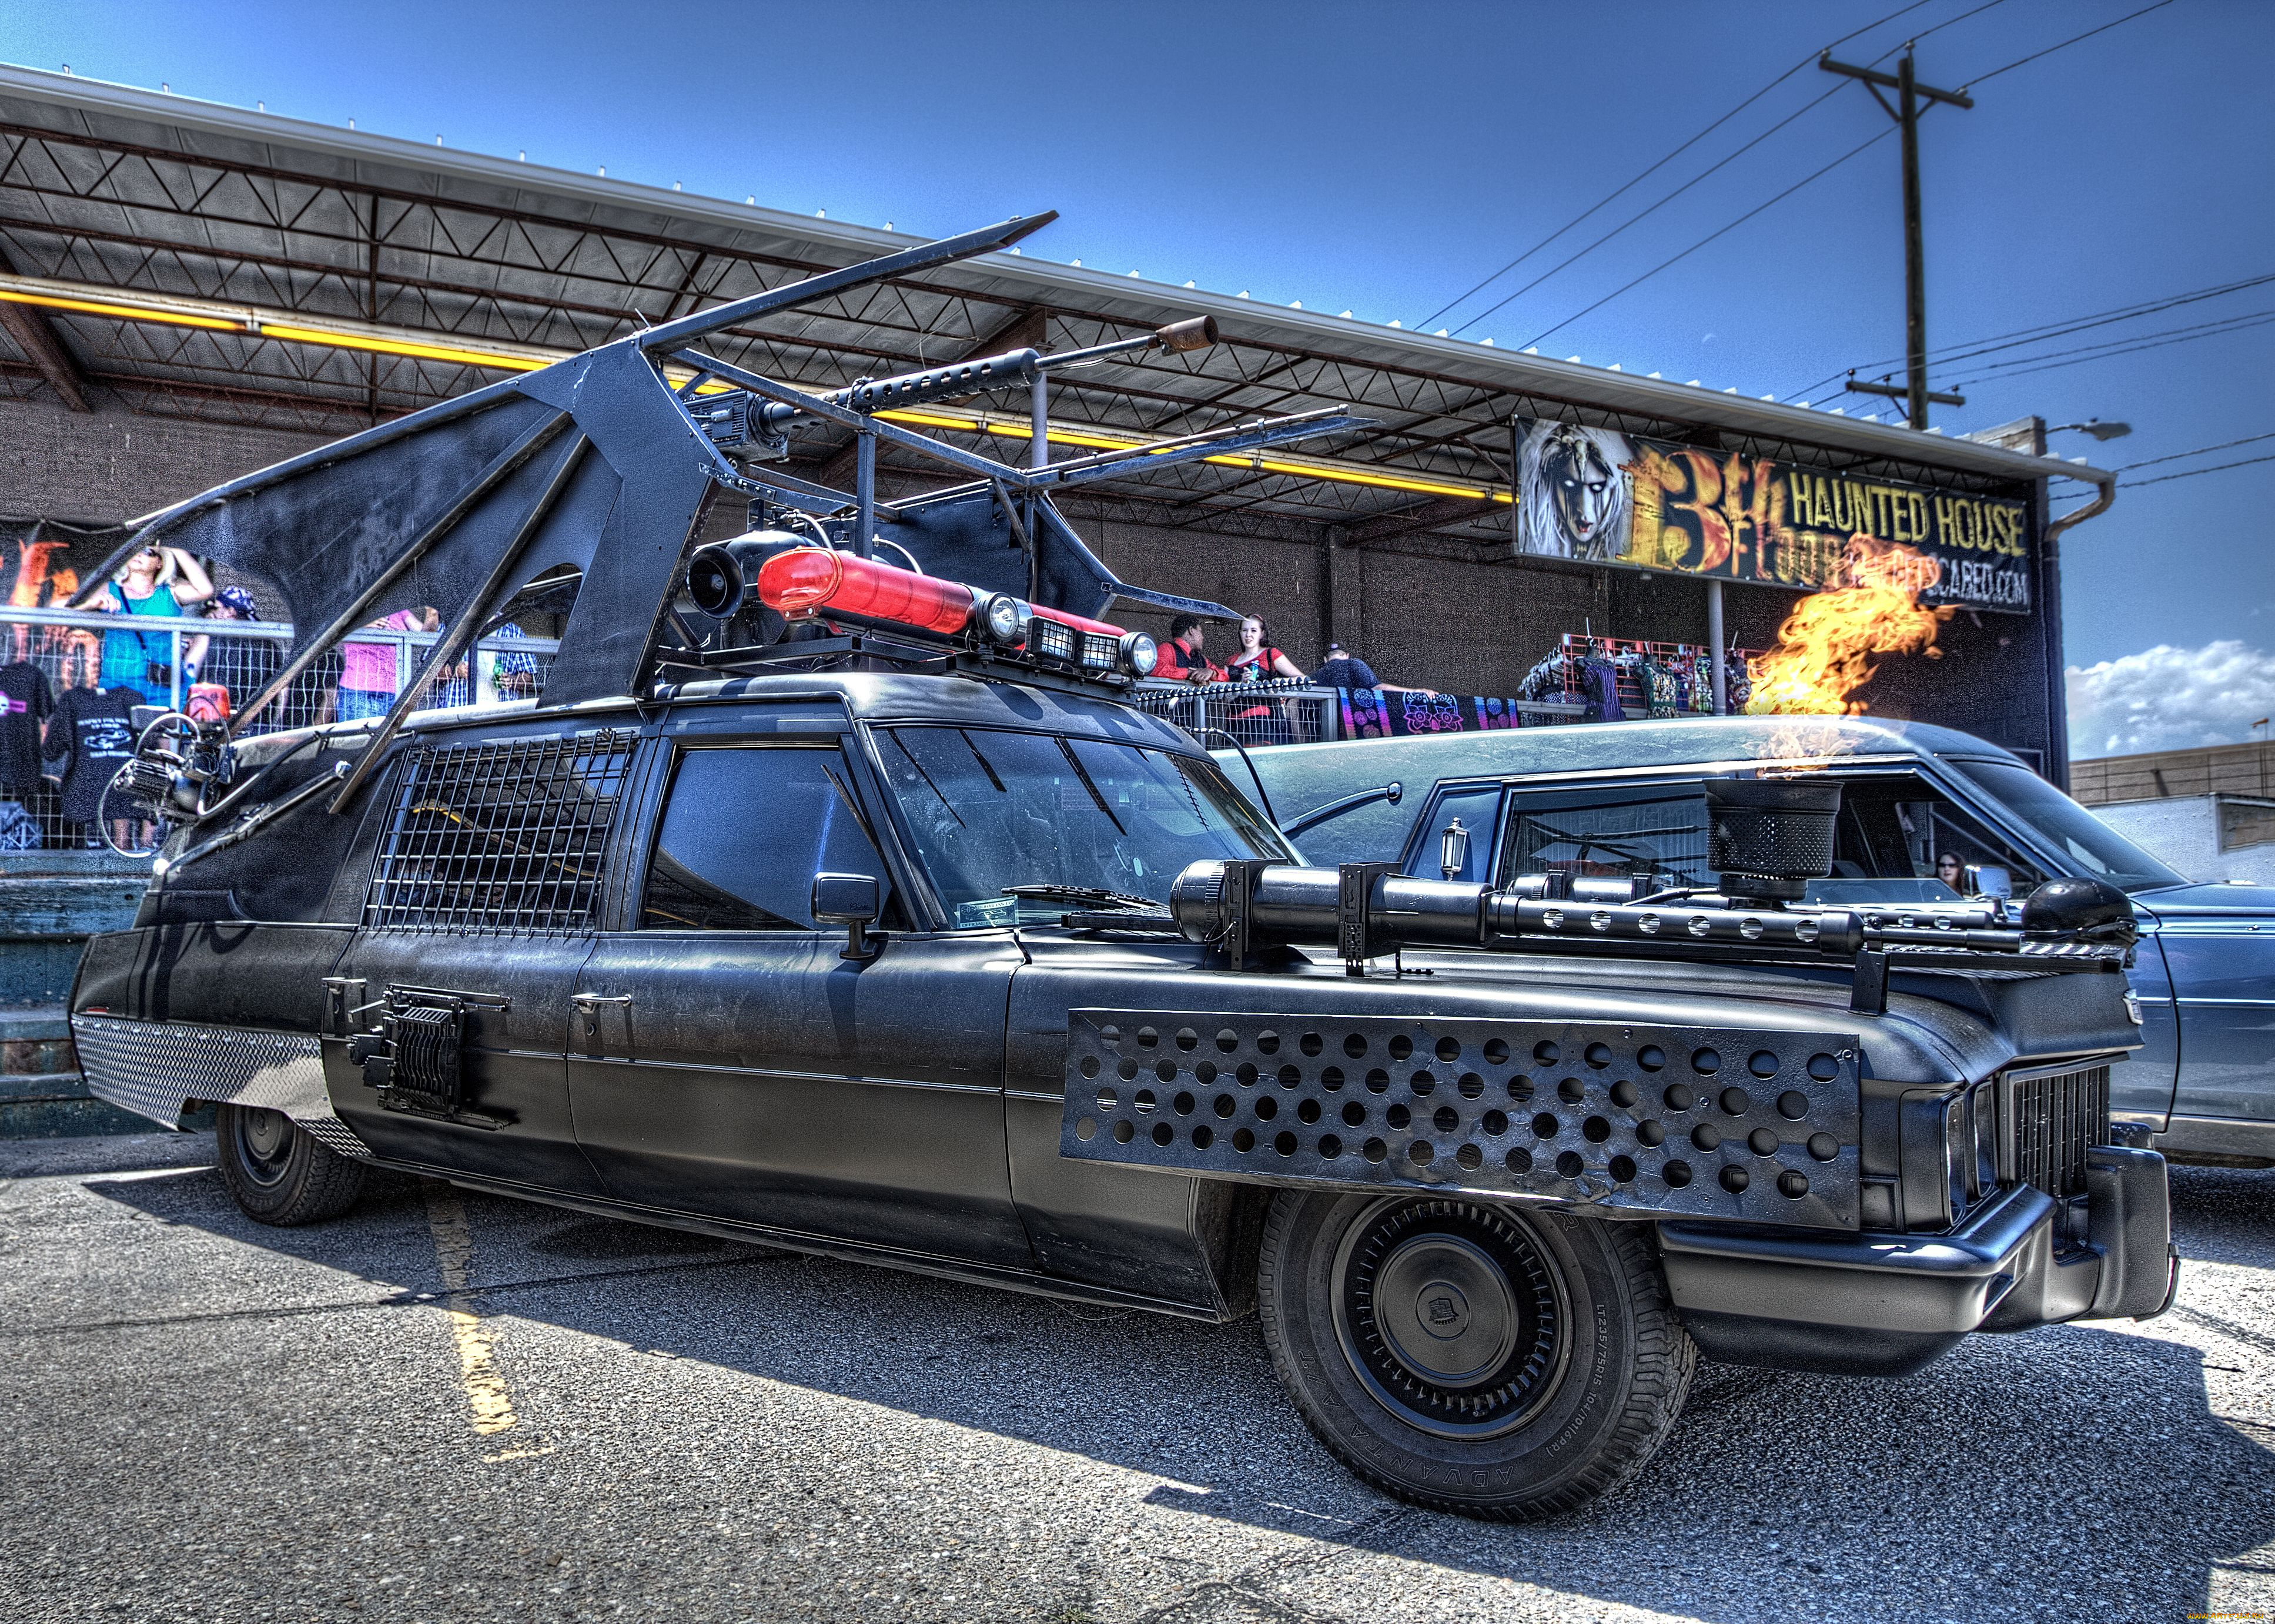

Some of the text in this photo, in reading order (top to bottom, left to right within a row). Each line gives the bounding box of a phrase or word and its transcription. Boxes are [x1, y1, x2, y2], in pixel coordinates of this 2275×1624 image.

[1789, 472, 2026, 557] HAUNTED HOUSE
[1592, 1304, 1607, 1386] LT235/75R15
[1297, 1351, 1514, 1488] ADVANTA A/T
